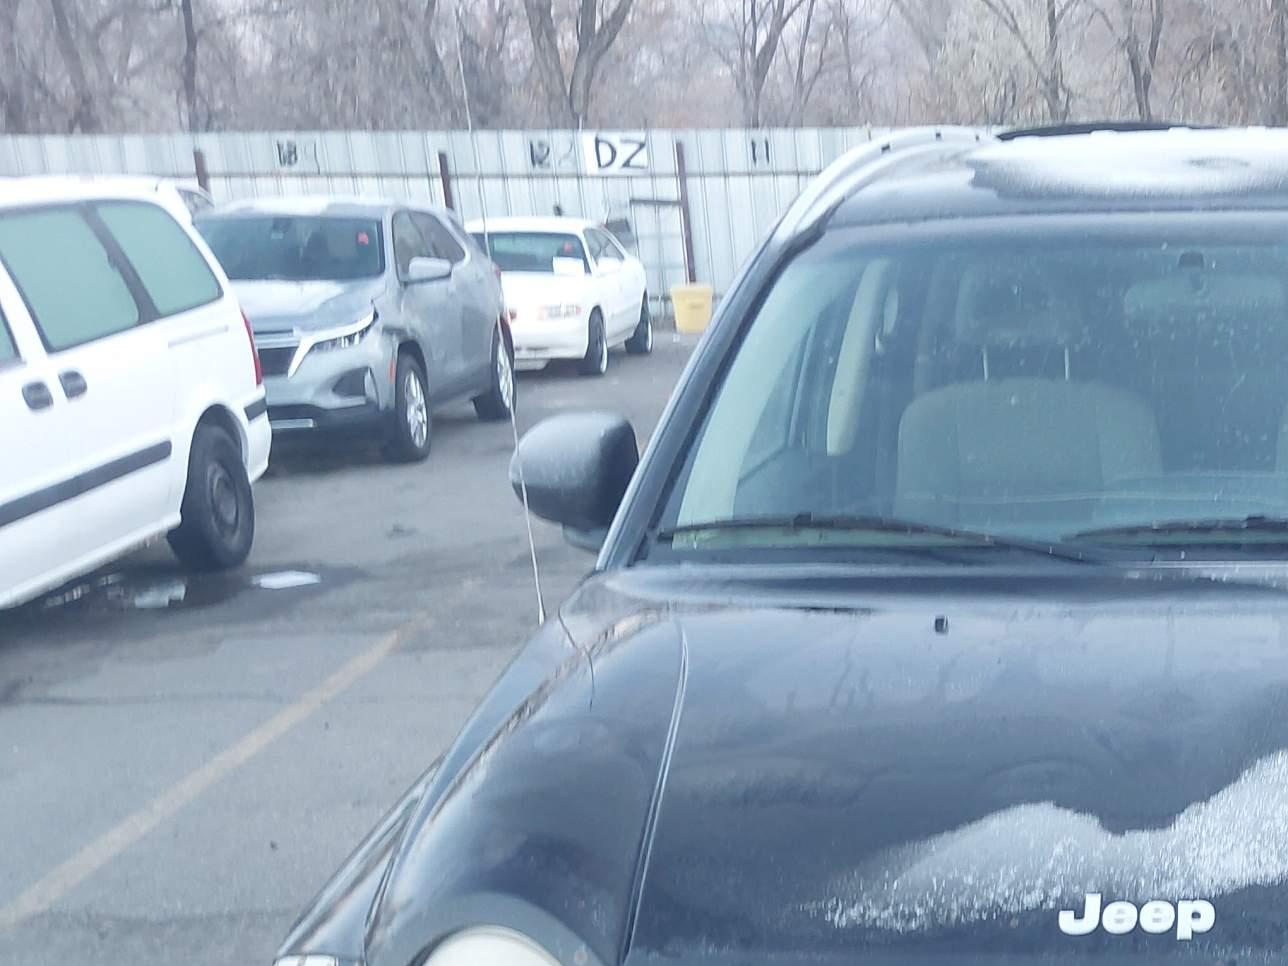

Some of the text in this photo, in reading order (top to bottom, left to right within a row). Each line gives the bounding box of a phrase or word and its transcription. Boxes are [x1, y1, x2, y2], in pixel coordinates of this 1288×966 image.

[594, 136, 648, 169] DZ
[751, 138, 770, 167] 11
[1058, 893, 1216, 941] Jeep
